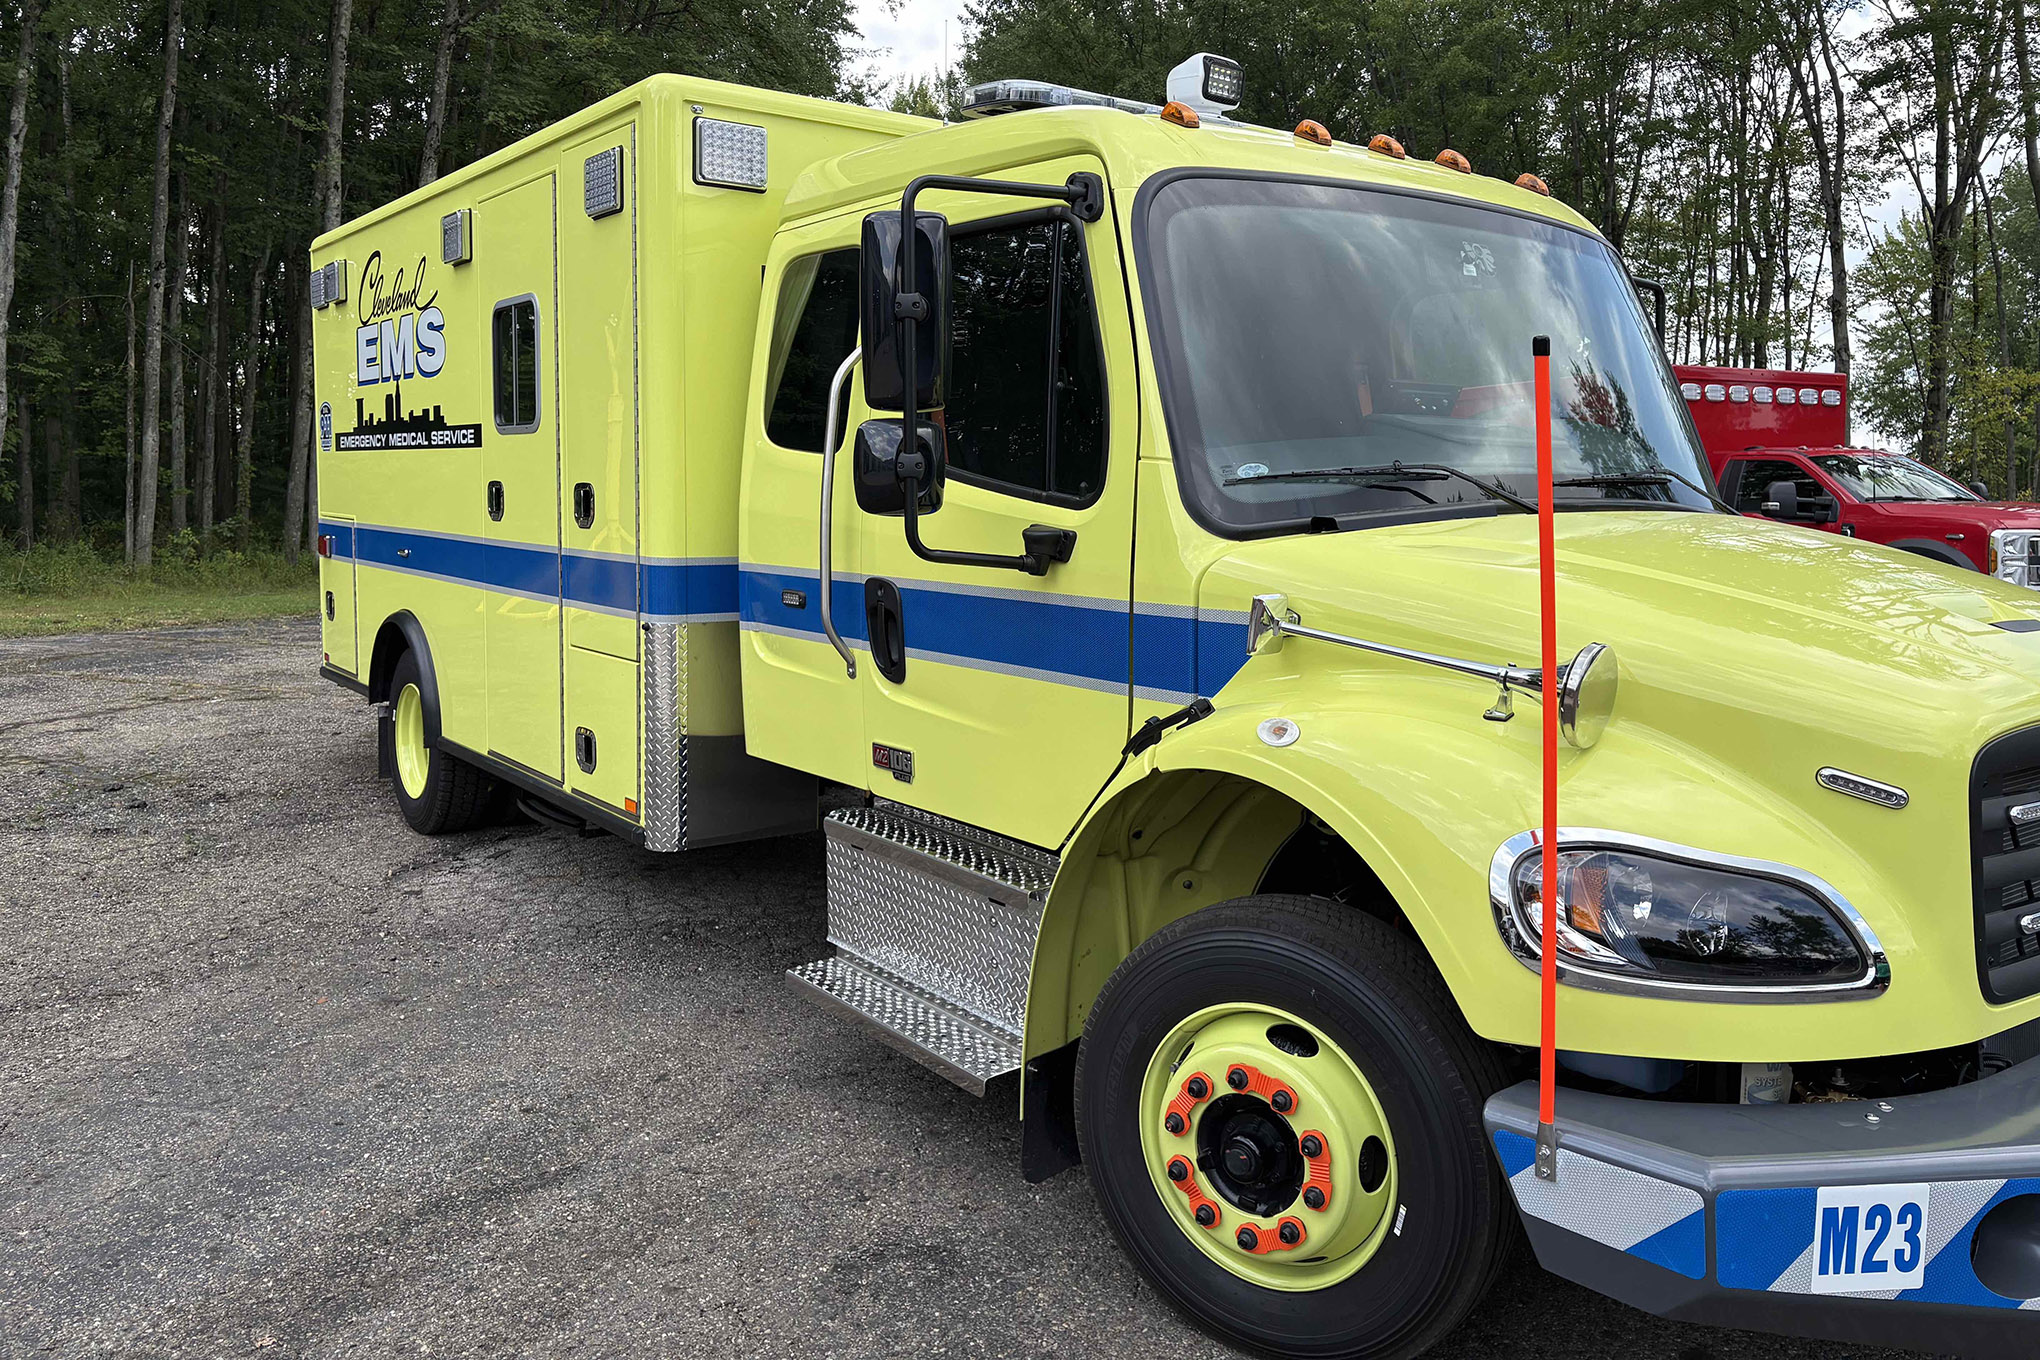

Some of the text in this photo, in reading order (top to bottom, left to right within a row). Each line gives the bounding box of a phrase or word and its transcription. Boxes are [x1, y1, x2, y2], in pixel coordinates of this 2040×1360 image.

[358, 250, 438, 326] Cleveland
[356, 306, 446, 386] EMS
[340, 429, 475, 448] EMERGENCY MEDICAL SERVICE
[889, 749, 911, 772] 106
[1818, 1202, 1923, 1276] M23
